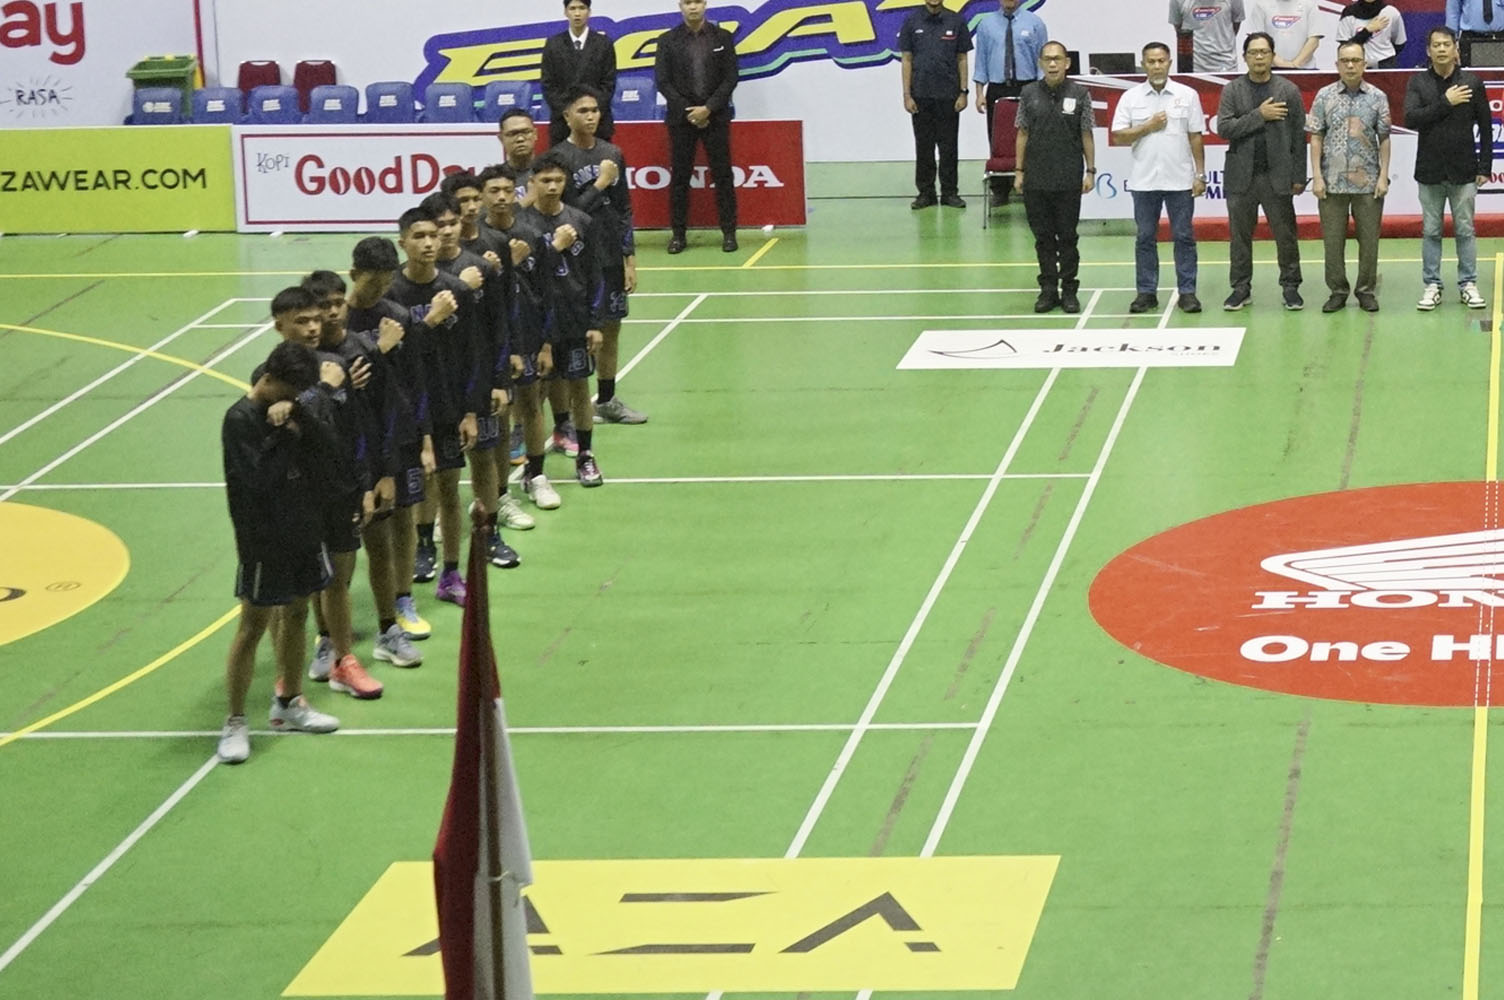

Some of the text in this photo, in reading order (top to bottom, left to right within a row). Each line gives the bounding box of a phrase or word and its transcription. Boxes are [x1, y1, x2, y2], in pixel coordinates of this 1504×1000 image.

[15, 88, 61, 106] RASA
[1, 167, 207, 192] ZAWEAR.COM
[256, 152, 290, 174] KOPI
[294, 153, 404, 196] Good
[1042, 342, 1221, 354] Jackson
[1240, 634, 1411, 662] One
